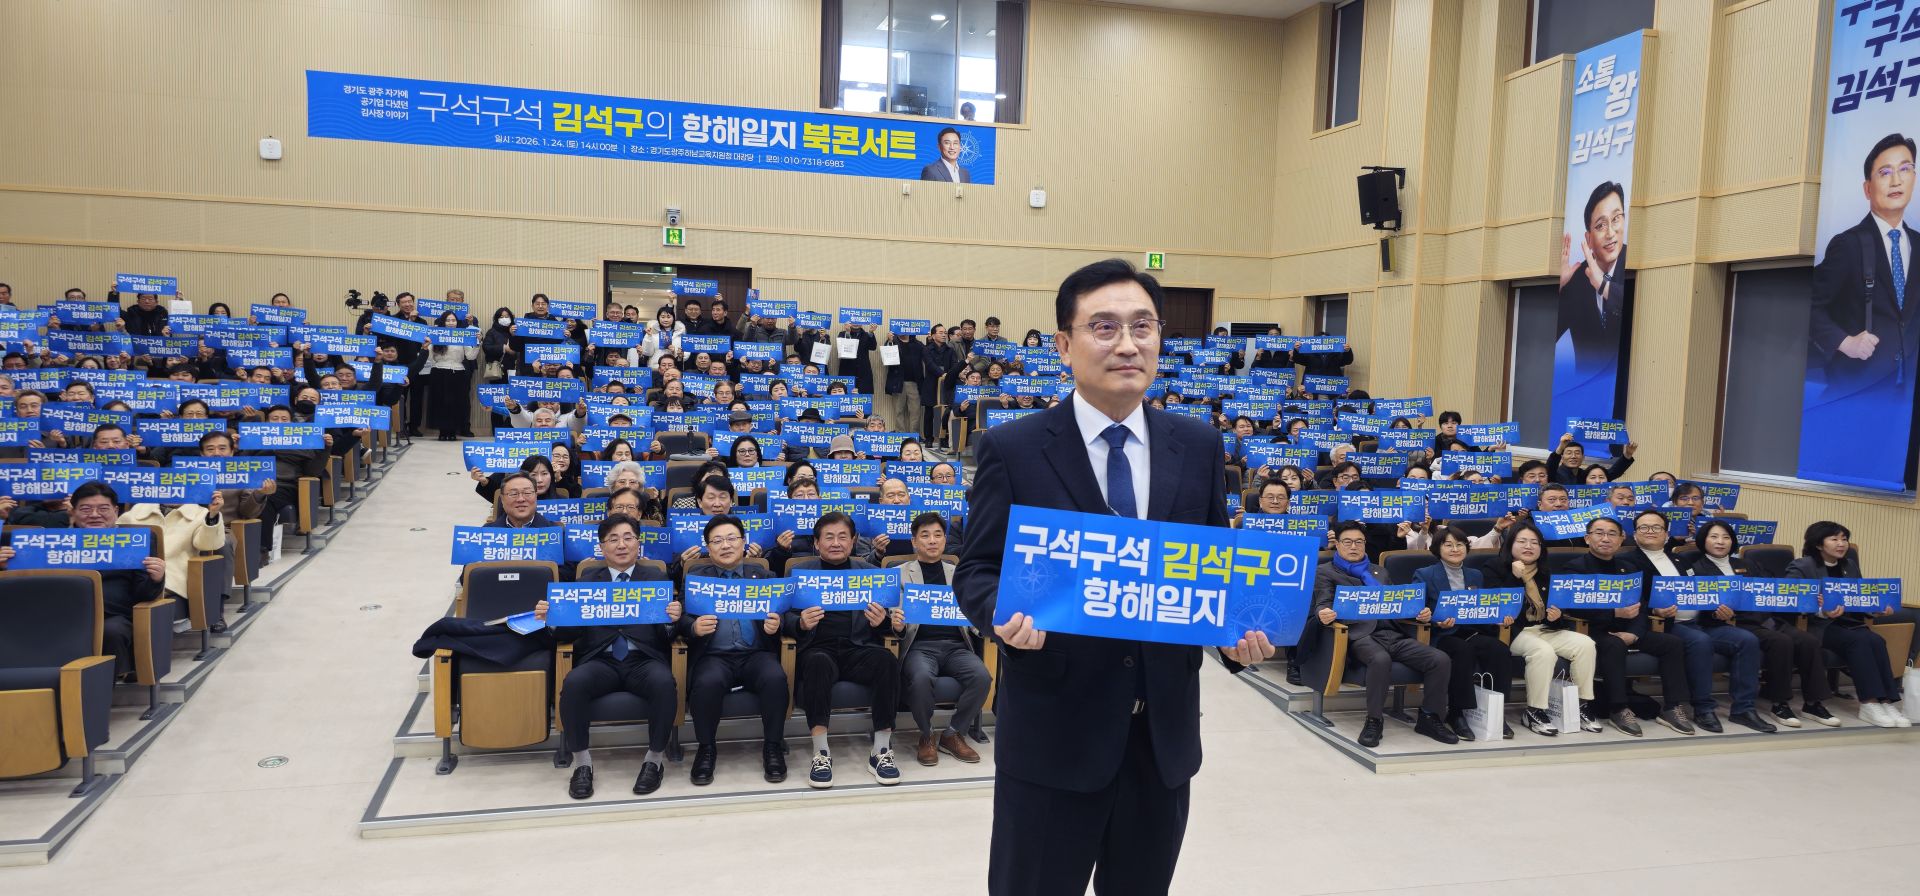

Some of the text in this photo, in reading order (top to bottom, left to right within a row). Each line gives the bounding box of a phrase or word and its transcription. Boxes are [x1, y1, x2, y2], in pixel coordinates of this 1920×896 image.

[343, 85, 409, 99] 경기도 광주 자가에
[1576, 55, 1638, 120] 소통 왕
[360, 97, 409, 110] 공기업 다녔던
[361, 108, 409, 120] 김사장 이야기
[417, 91, 916, 160] 구석구석 김석구의 항해일지 북콘서트
[494, 134, 510, 144] 일시
[1571, 120, 1635, 164] 김석구
[630, 145, 645, 154] 장소
[733, 153, 755, 162] 대강당
[766, 154, 781, 164] 문의
[784, 156, 845, 168] 010-7318-6983
[72, 372, 144, 382] 구석구석 김석구의
[511, 380, 542, 389] 구석구석
[546, 381, 579, 390] 김석구의
[96, 390, 176, 400] 구석구석 김석구의
[182, 389, 258, 398] 구석구석 김석구의
[528, 389, 561, 399] 항해일지
[42, 409, 131, 424] 구석구석 김석구의
[317, 408, 389, 418] 구석구석 김석구의
[140, 422, 225, 432] 구석구석 김석구의
[335, 416, 370, 426] 항해일지
[1568, 421, 1599, 430] 구석구석
[241, 426, 323, 436] 구석구석 김석구의
[785, 425, 814, 434] 구석구석
[1584, 431, 1616, 440] 항해일지
[262, 436, 302, 445] 항해일지
[497, 431, 569, 441] 구석구석 김석구의
[800, 435, 831, 444] 항해일지
[856, 434, 885, 443] 구석구석
[465, 446, 550, 457] 구석구석 김석구의
[1250, 446, 1317, 458] 구석구석 김석구의
[31, 453, 134, 465] 구석구석 김석구의
[1267, 457, 1300, 466] 항해일지
[1348, 455, 1377, 465] 구석구석
[1444, 454, 1510, 464] 구석구석 김석구의
[226, 461, 274, 472] 김석구의
[843, 464, 879, 473] 김석구의
[888, 465, 922, 475] 구석구석
[1362, 466, 1391, 474] 항해일지
[1460, 465, 1492, 473] 항해일지
[42, 468, 98, 481] 김석구의
[105, 471, 214, 485] 구석구석 김석구의
[747, 469, 784, 480] 김석구의
[824, 474, 860, 483] 항해일지
[12, 482, 68, 495] 항해일지
[131, 485, 185, 498] 항해일지
[908, 488, 941, 500] 구석구석
[1578, 487, 1607, 498] 김석구의
[1634, 483, 1668, 494] 김석구의
[1302, 495, 1337, 504] 김석구의
[1341, 495, 1424, 506] 구석구석 김석구의
[1431, 491, 1507, 504] 구석구석 김석구의
[537, 504, 579, 515] 구석구석
[774, 503, 866, 516] 구석구석 김석구의
[868, 508, 906, 521] 구석구석
[1362, 507, 1402, 518] 항해일지
[1450, 504, 1488, 515] 항해일지
[1536, 506, 1613, 524] 구석구석 김석구의
[1246, 517, 1327, 530] 구석구석 김석구의
[1739, 523, 1774, 534] 김석구의
[14, 533, 147, 548] 구석구석 김석구의
[457, 532, 560, 545] 구석구석 김석구의
[48, 550, 112, 564] 항해일지
[484, 548, 536, 560] 항해일지
[1014, 525, 1307, 590] 구석구석 김석구의
[798, 575, 898, 588] 구석구석 김석구의
[1553, 578, 1641, 591] 구석구석 김석구의
[1654, 580, 1741, 592] 구석구석 김석구의
[689, 582, 795, 598] 구석구석 김석구의
[1778, 583, 1819, 595] 김석구의
[1825, 582, 1899, 594] 구석구석 김석구의
[551, 588, 670, 603] 구석구석 김석구의
[821, 590, 872, 604] 항해일지
[906, 589, 953, 603] 구석구석
[1338, 589, 1424, 602] 구석구석 김석구의
[1440, 592, 1521, 606] 구석구석 김석구의
[1574, 592, 1621, 604] 항해일지
[1677, 594, 1719, 605] 항해일지
[1755, 594, 1798, 607] 항해일지
[1844, 595, 1880, 607] 항해일지
[715, 600, 770, 613] 항해일지
[1083, 577, 1226, 627] 항해일지
[1359, 602, 1401, 614] 항해일지
[581, 604, 640, 618] 항해일지
[1458, 608, 1499, 619] 항해일지
